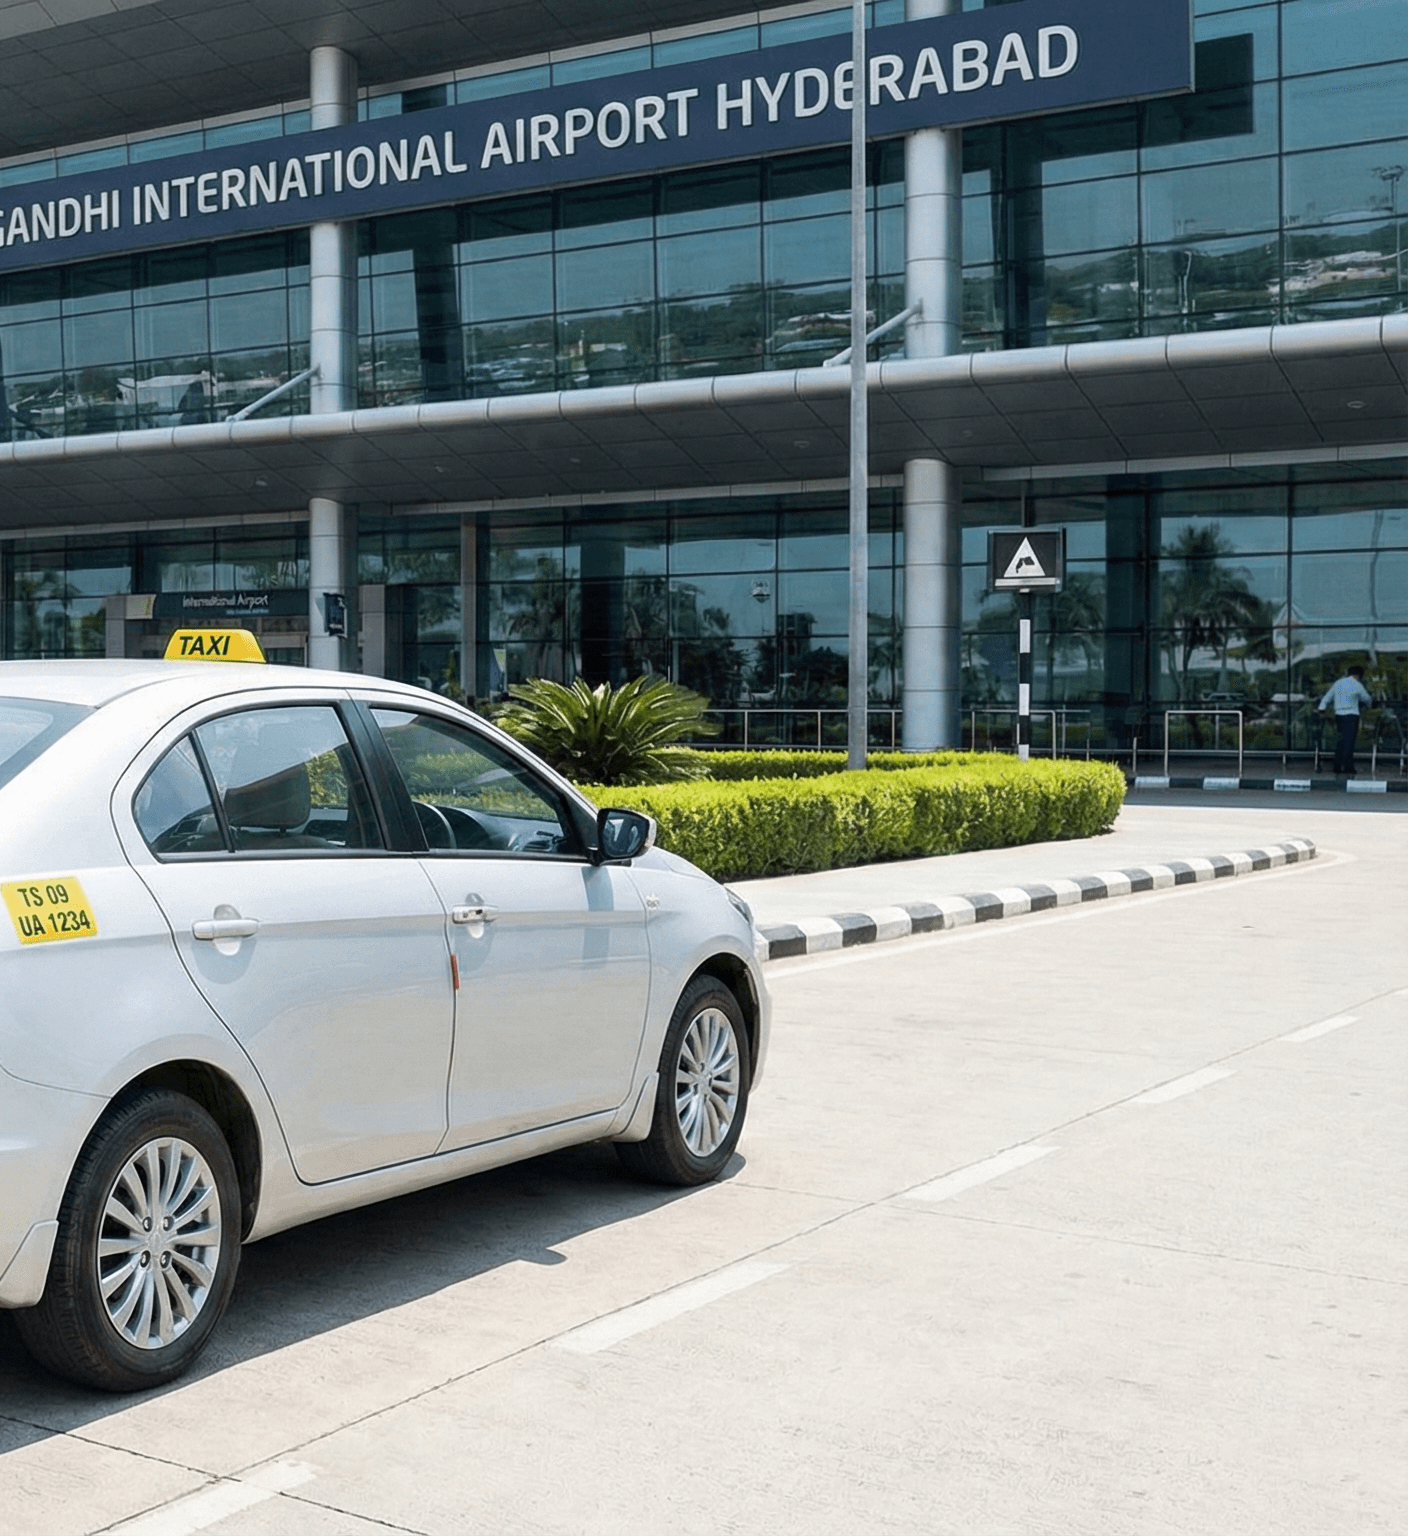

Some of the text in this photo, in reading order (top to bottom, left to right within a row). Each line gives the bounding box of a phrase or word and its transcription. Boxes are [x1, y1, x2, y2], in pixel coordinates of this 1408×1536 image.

[133, 130, 468, 226] INTERNATIONAL
[480, 88, 699, 170] AIRPORT
[717, 24, 1079, 130] HYDERABAD
[179, 635, 231, 656] TAXI
[17, 884, 69, 908] TS 09
[18, 909, 91, 937] UA 1234
